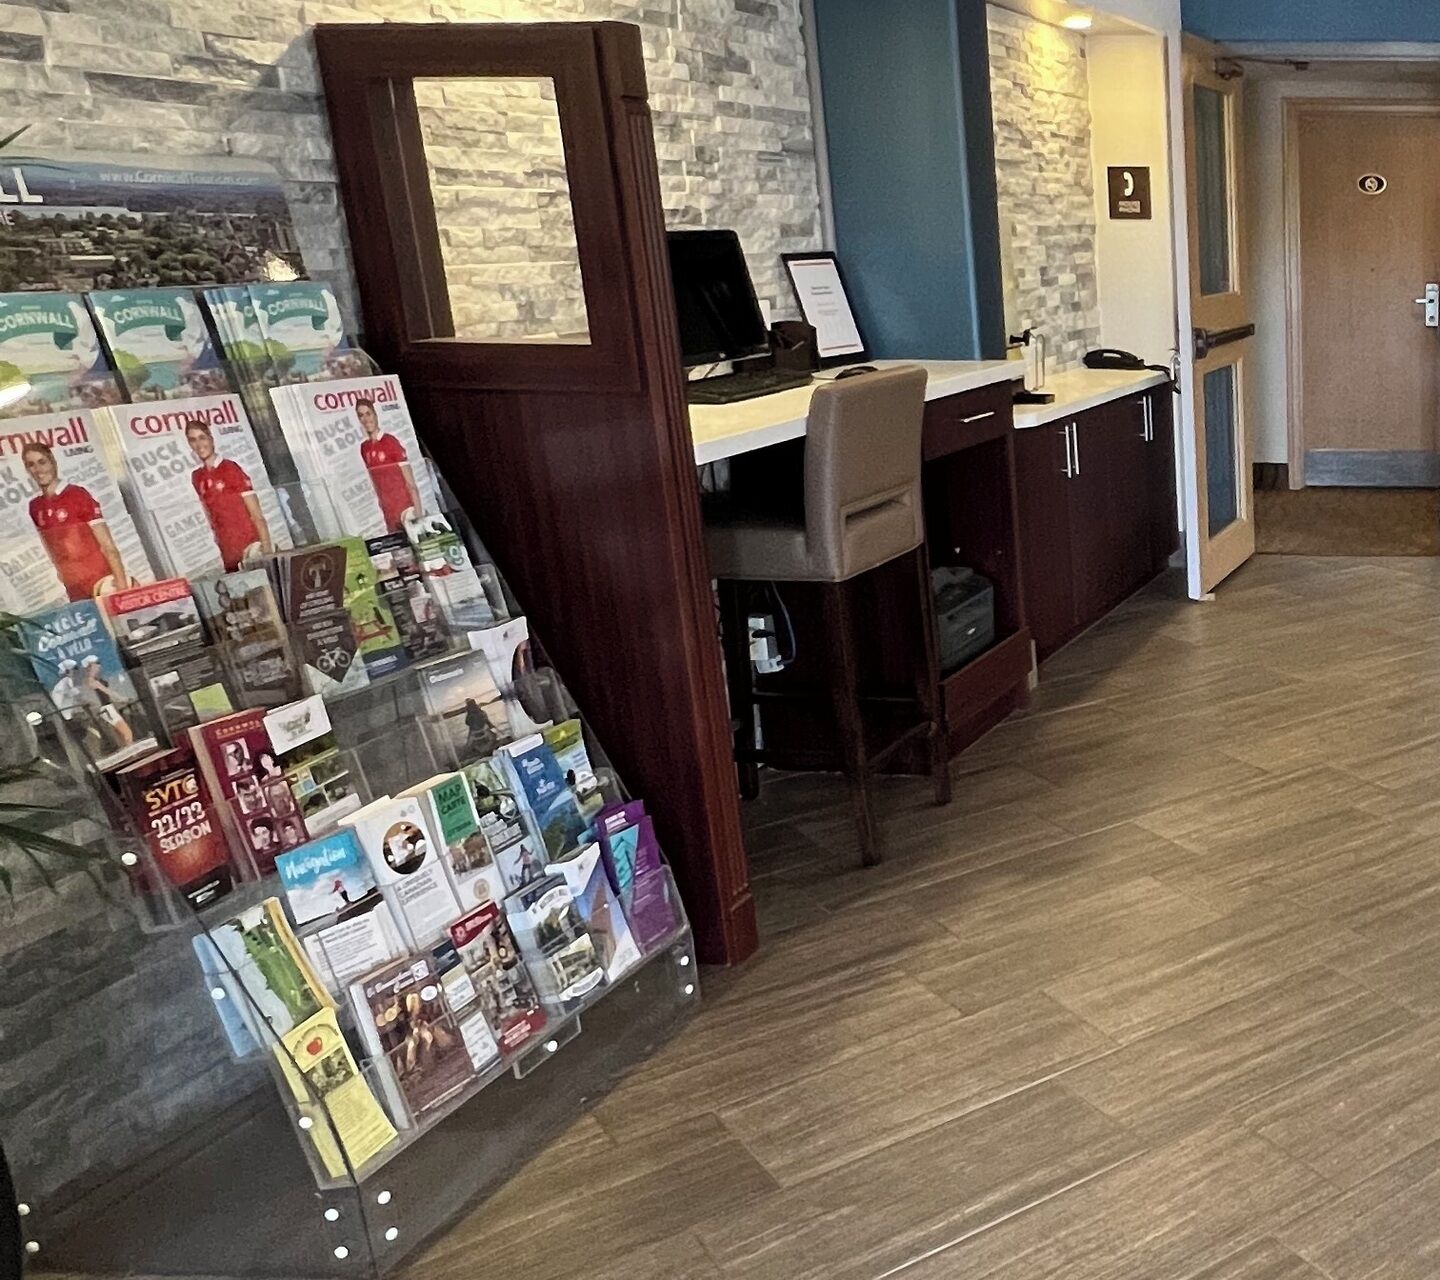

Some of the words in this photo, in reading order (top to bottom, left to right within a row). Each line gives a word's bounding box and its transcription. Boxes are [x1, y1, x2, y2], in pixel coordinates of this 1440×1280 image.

[313, 381, 398, 411] cornwall
[130, 400, 240, 436] cornwall
[314, 416, 354, 443] RUCK
[131, 440, 181, 473] RUCK
[437, 783, 462, 805] MAP
[151, 801, 206, 839] 22/23
[159, 819, 212, 854] SEASON
